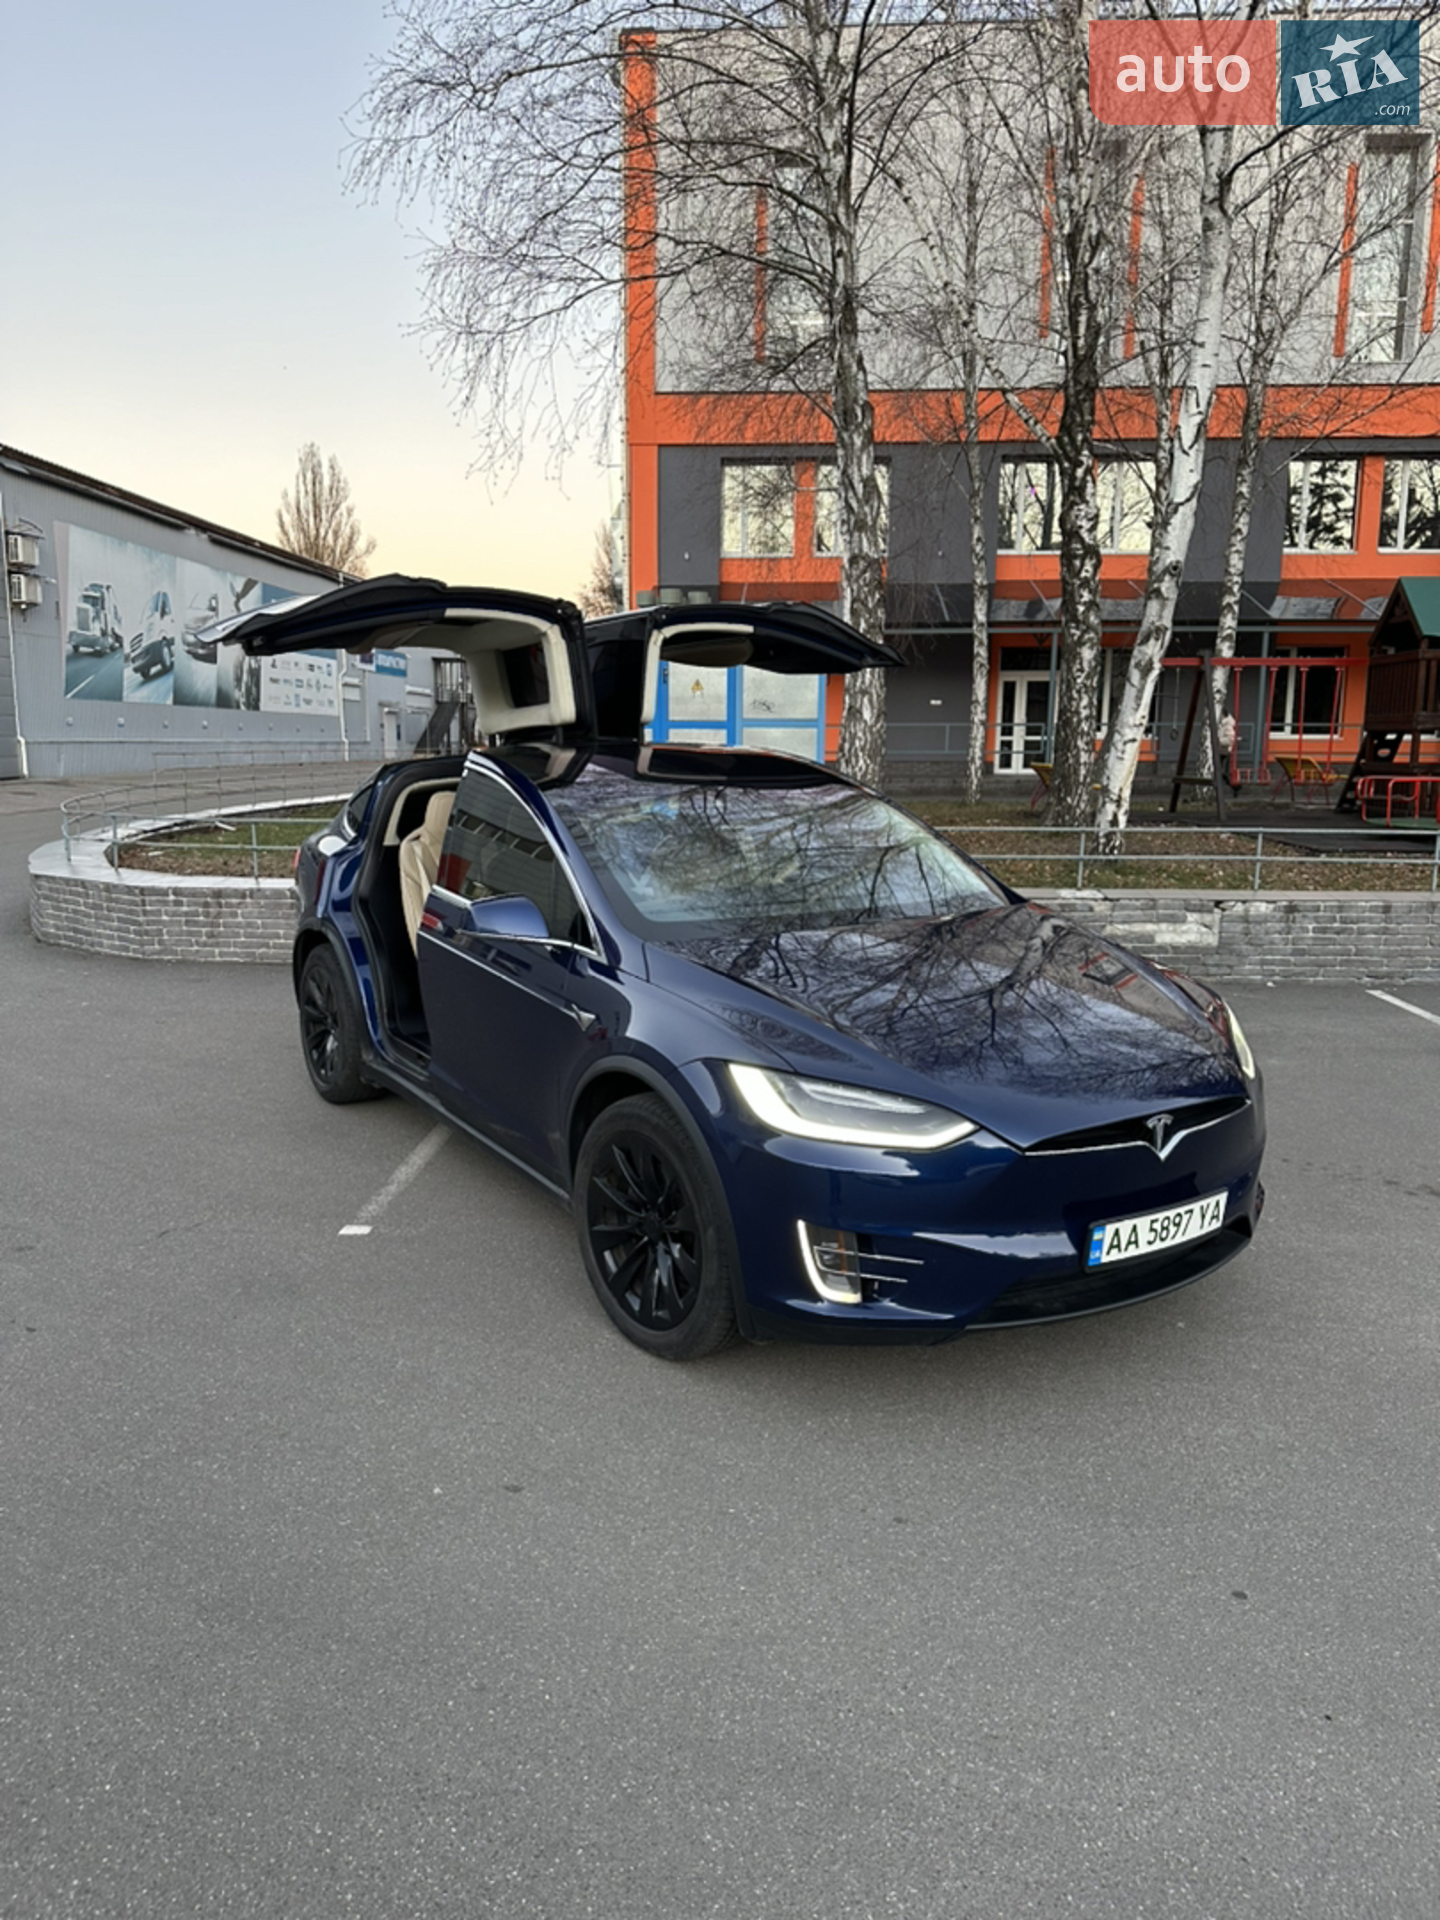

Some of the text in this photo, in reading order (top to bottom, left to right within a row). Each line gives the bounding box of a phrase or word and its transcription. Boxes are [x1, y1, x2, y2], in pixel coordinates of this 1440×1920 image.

[1106, 1199, 1221, 1256] AA 5897 YA
